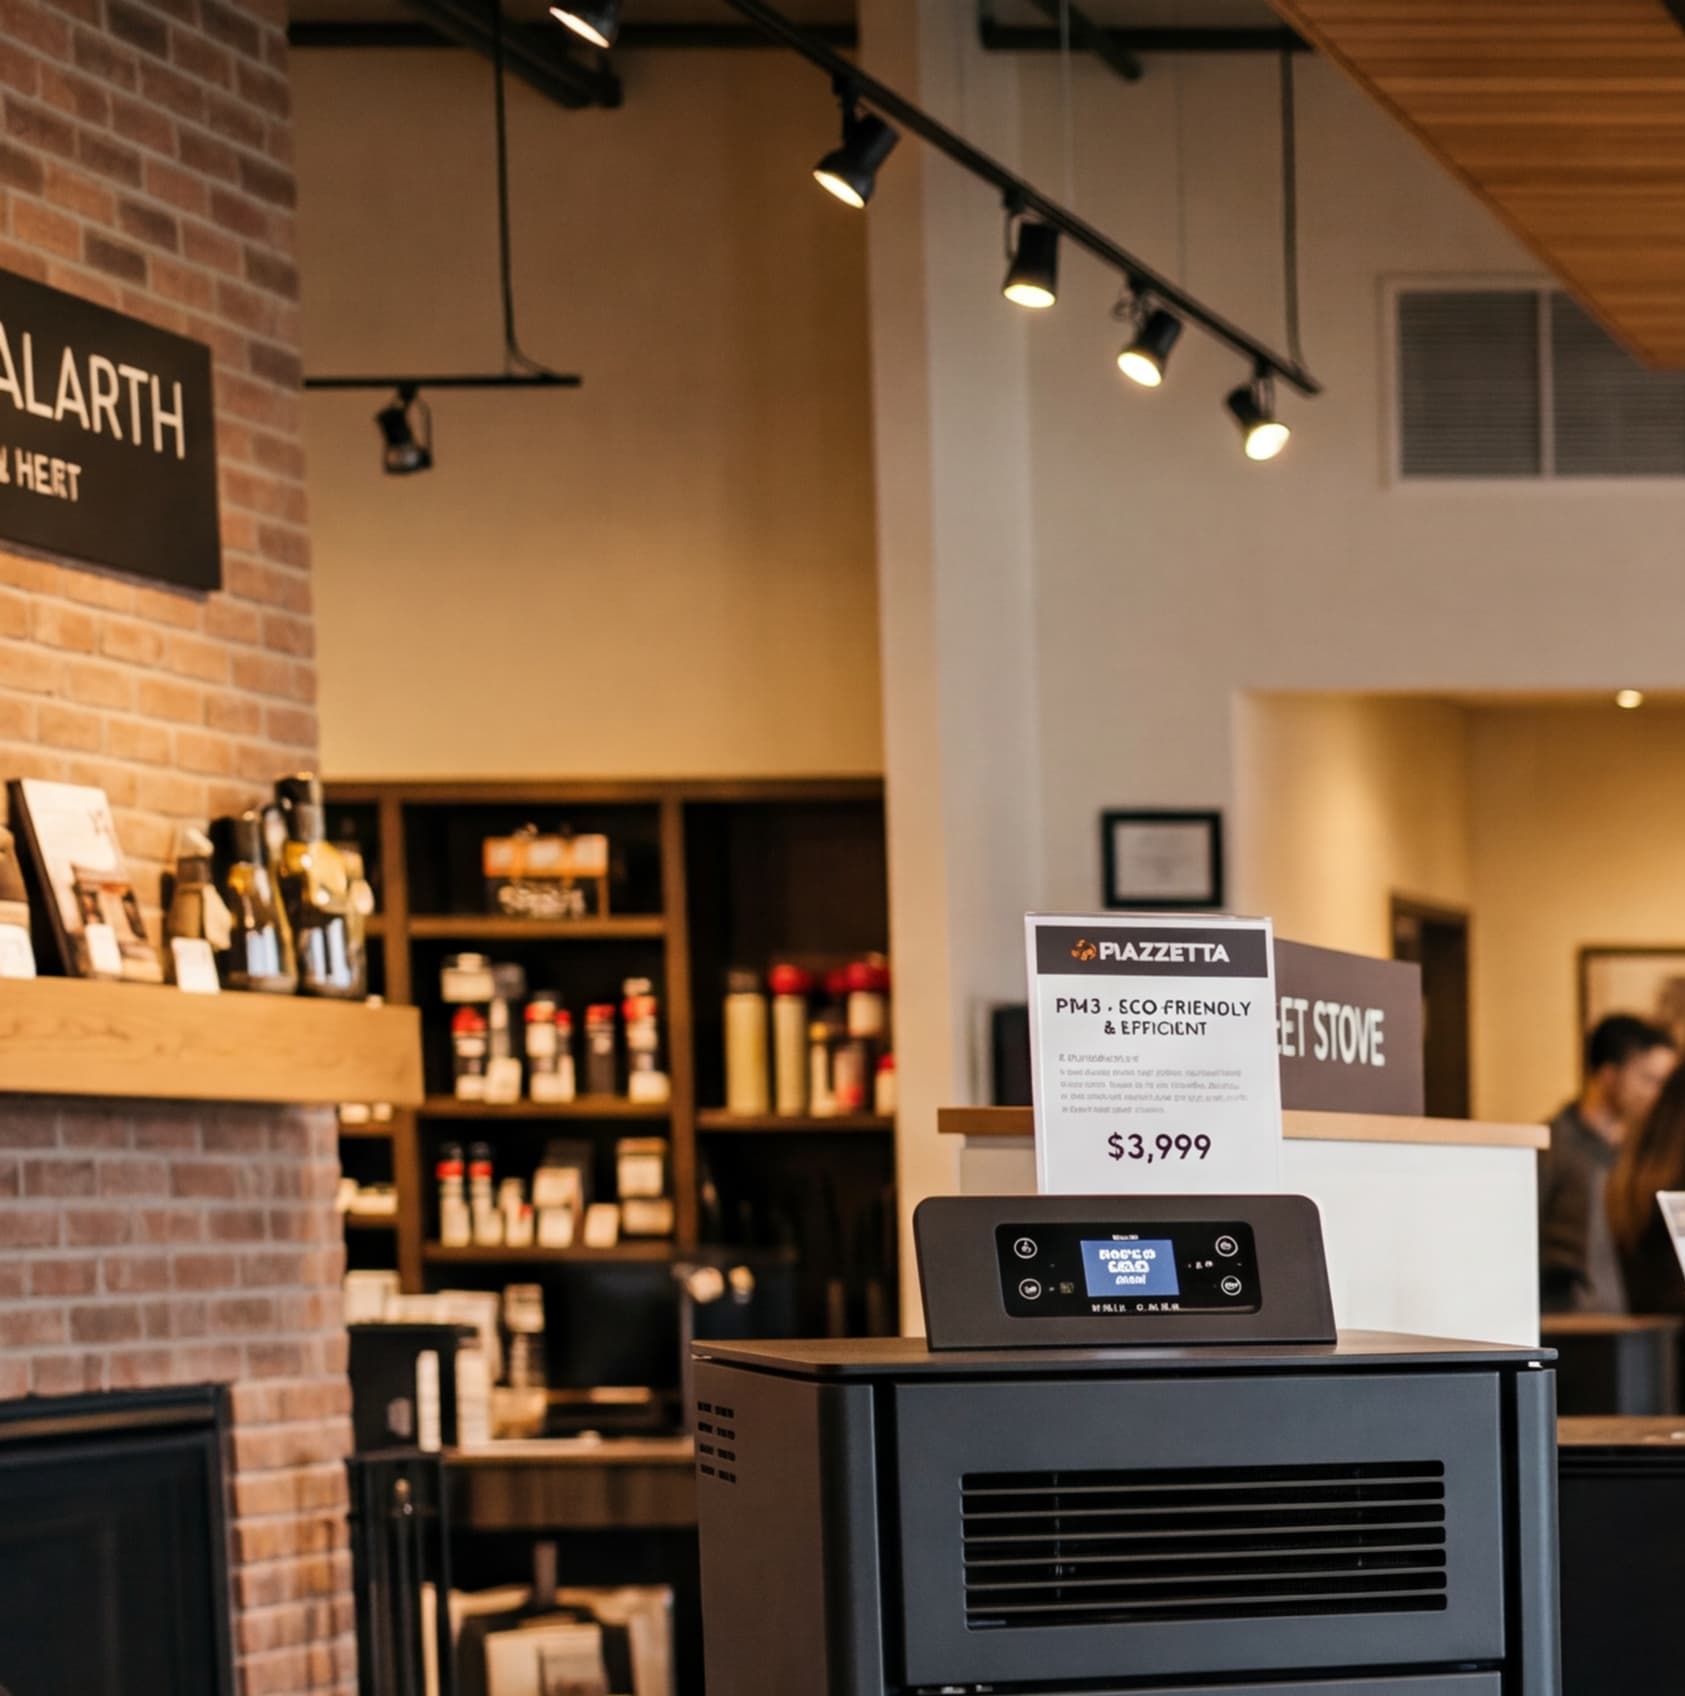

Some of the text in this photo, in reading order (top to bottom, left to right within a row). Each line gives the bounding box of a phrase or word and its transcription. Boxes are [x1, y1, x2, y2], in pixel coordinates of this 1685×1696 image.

[1099, 942, 1231, 963] PIAZZETTA
[1055, 998, 1101, 1014] PM3
[1275, 996, 1386, 1067] ET STOVE
[1107, 1131, 1212, 1164] $3,999
